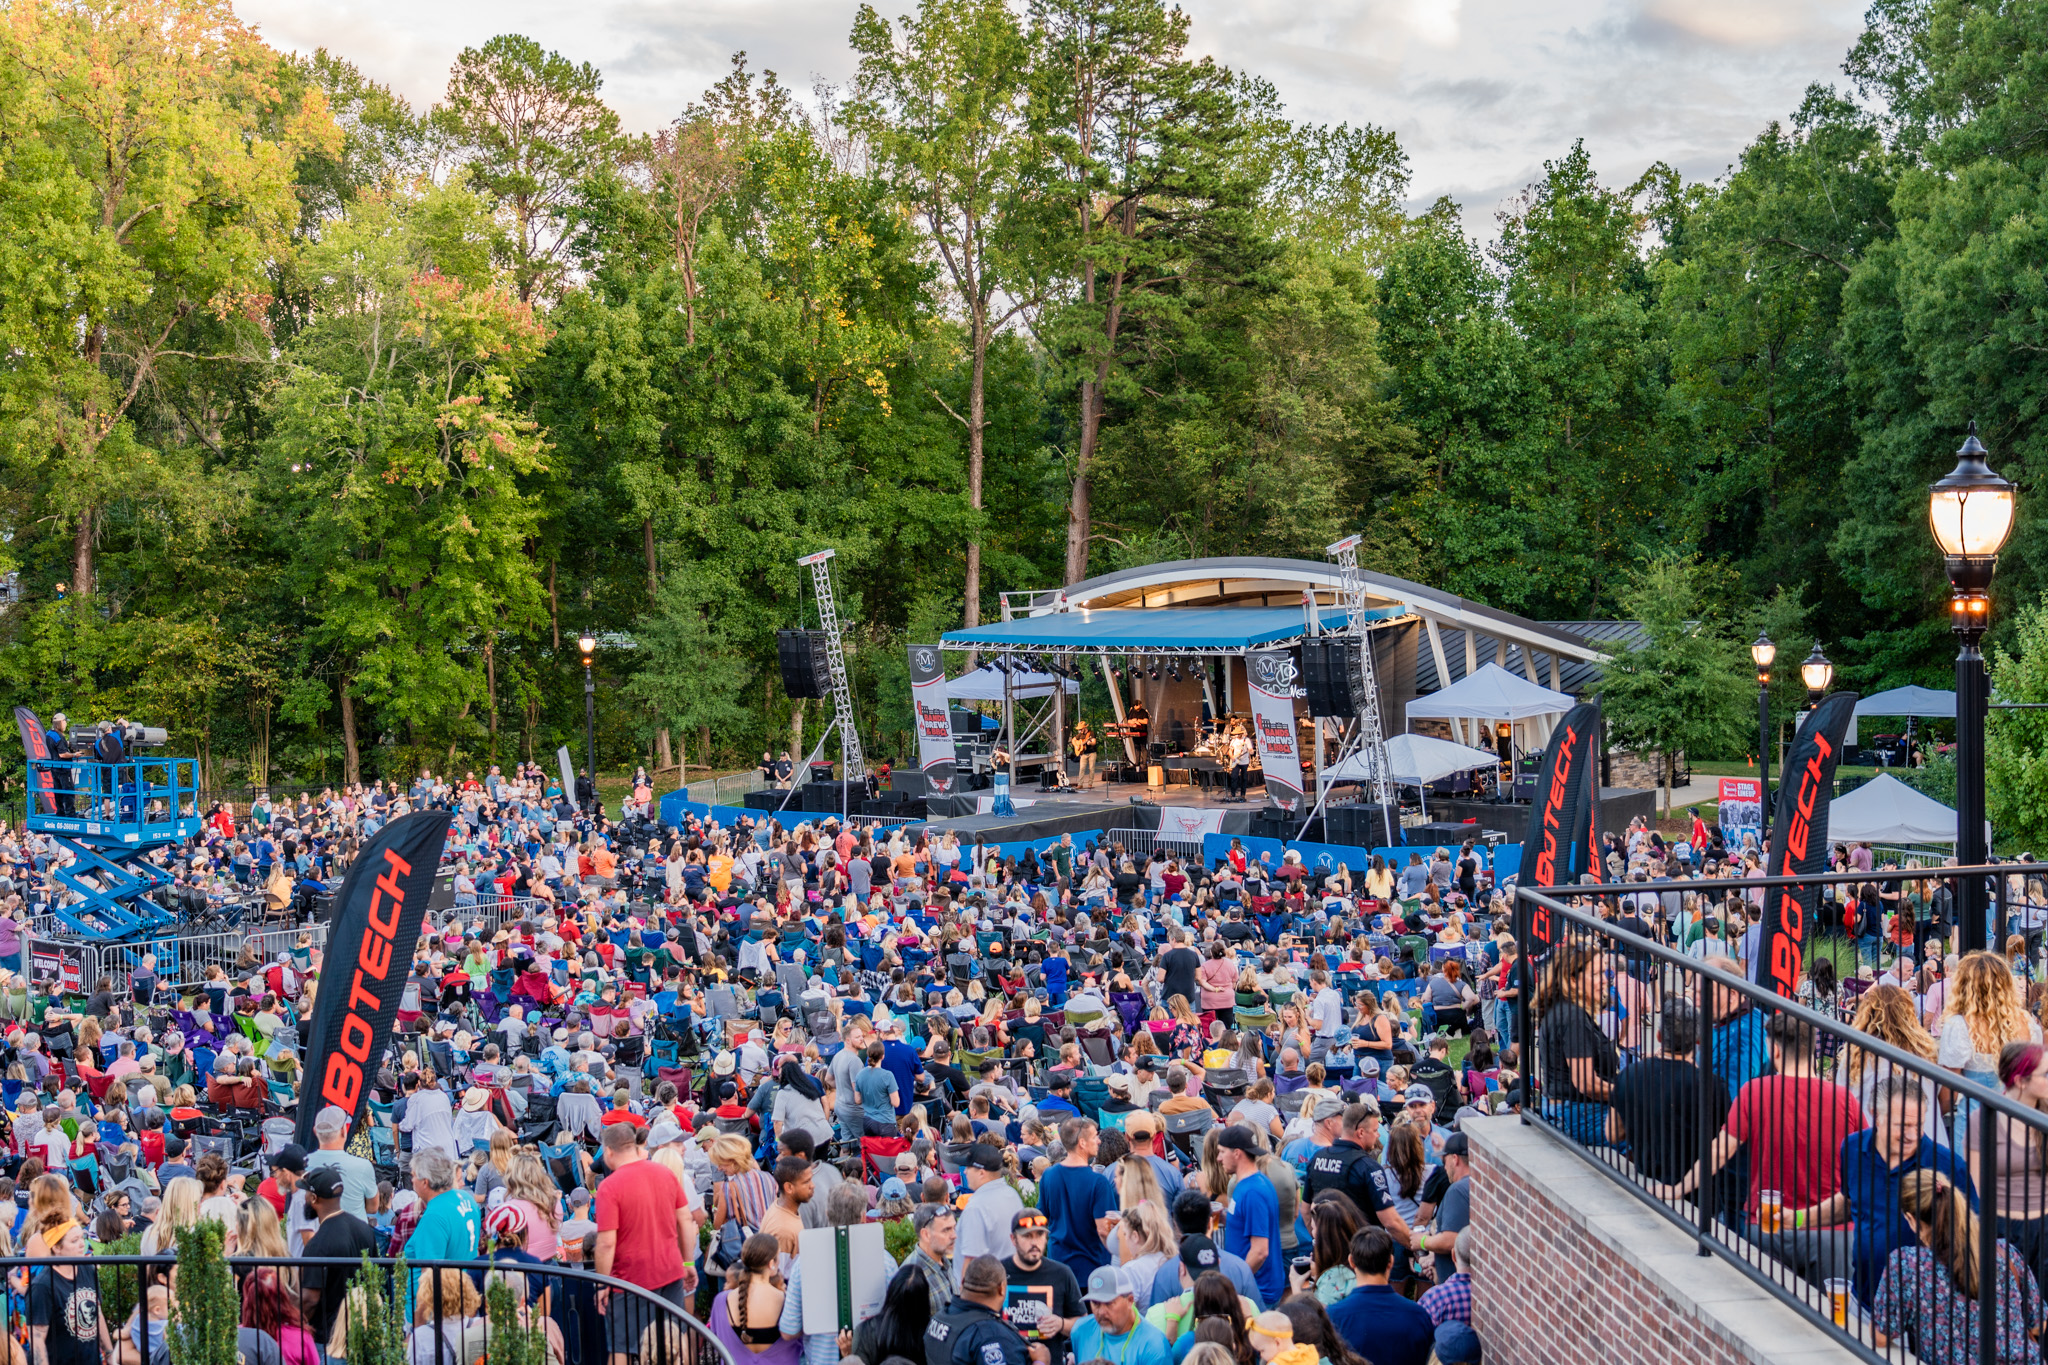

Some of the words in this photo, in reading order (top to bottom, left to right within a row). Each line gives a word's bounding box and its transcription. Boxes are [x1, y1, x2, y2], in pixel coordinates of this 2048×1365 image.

[924, 714, 946, 722] BANDS
[925, 721, 949, 729] BREWS
[1265, 728, 1290, 737] BANDS
[1266, 735, 1293, 745] BREWS
[1273, 744, 1292, 753] BBQ
[34, 958, 58, 970] WELCOME
[41, 969, 49, 979] TO
[1314, 1157, 1343, 1173] POLICE
[1017, 1300, 1035, 1309] THE
[1004, 1307, 1035, 1316] NORTH
[1012, 1315, 1034, 1324] FACE
